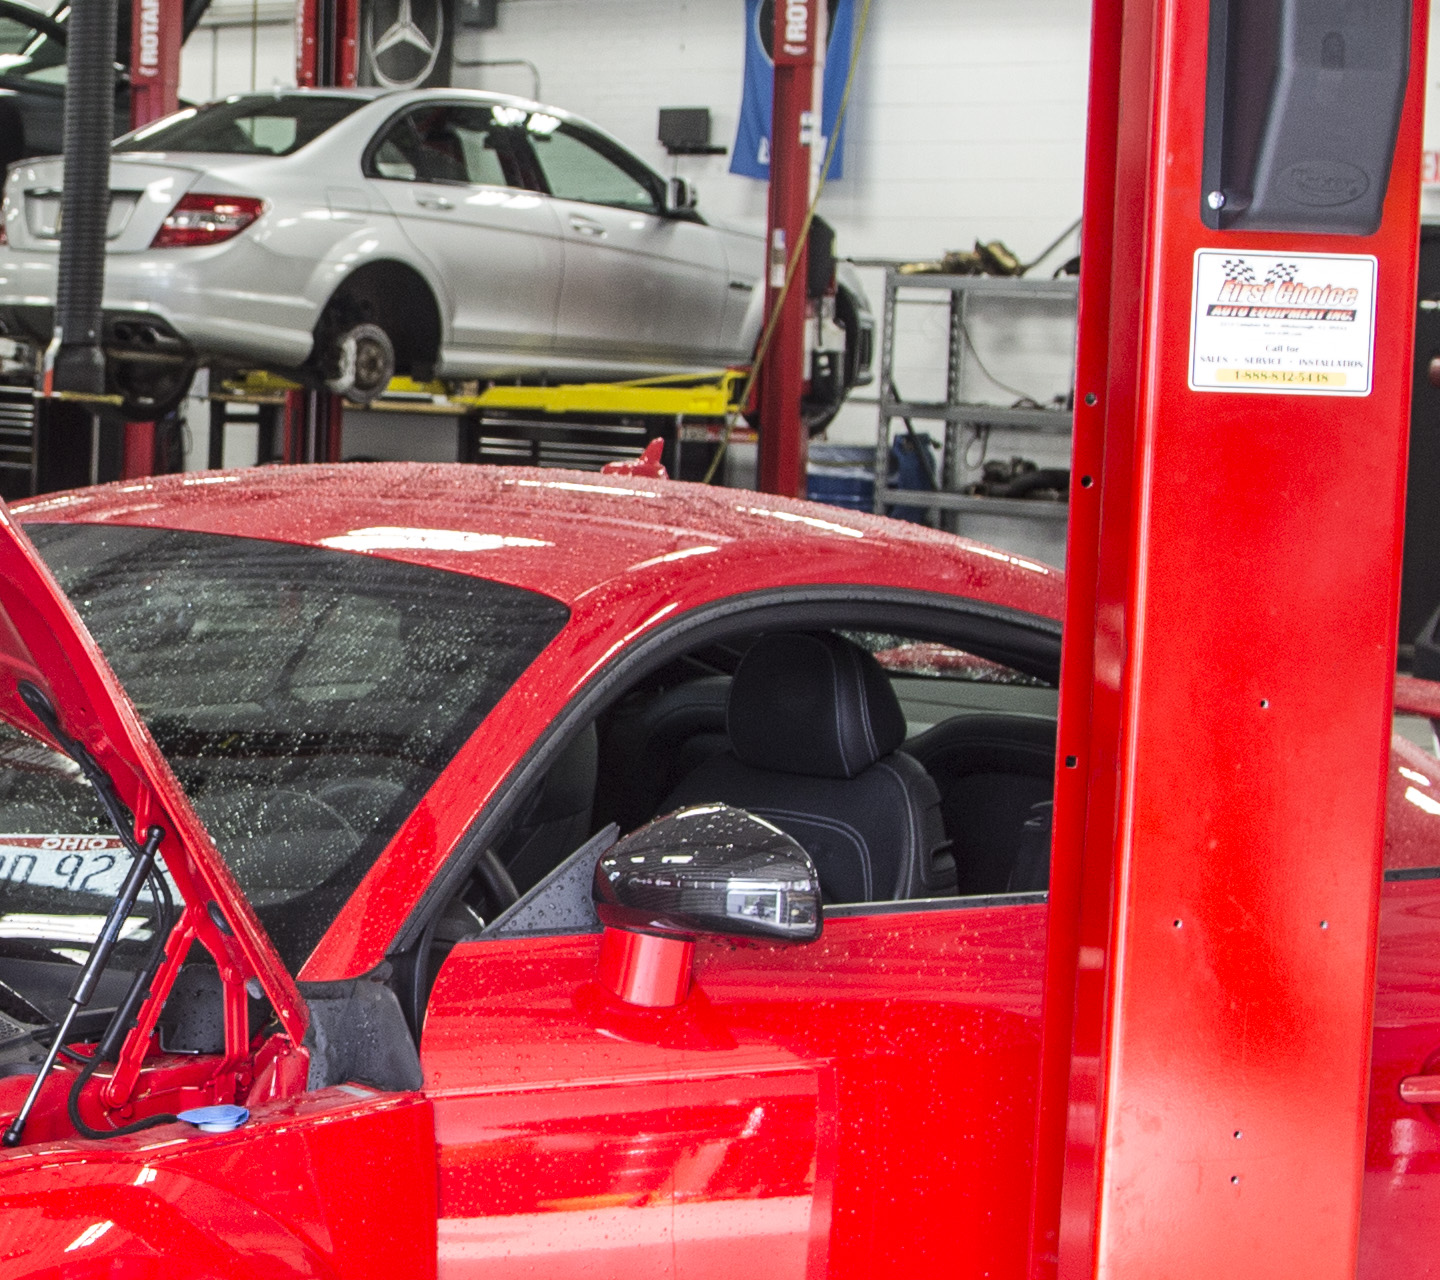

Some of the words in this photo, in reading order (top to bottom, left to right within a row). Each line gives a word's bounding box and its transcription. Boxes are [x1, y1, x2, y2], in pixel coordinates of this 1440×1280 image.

[1217, 280, 1276, 302] First
[1274, 281, 1358, 307] Choice
[1210, 306, 1250, 318] AUTO
[1248, 307, 1327, 320] EQUIPMENT
[1265, 345, 1283, 353] Call
[1245, 357, 1281, 365] SERVICE
[1299, 359, 1363, 368] INSTALLATION
